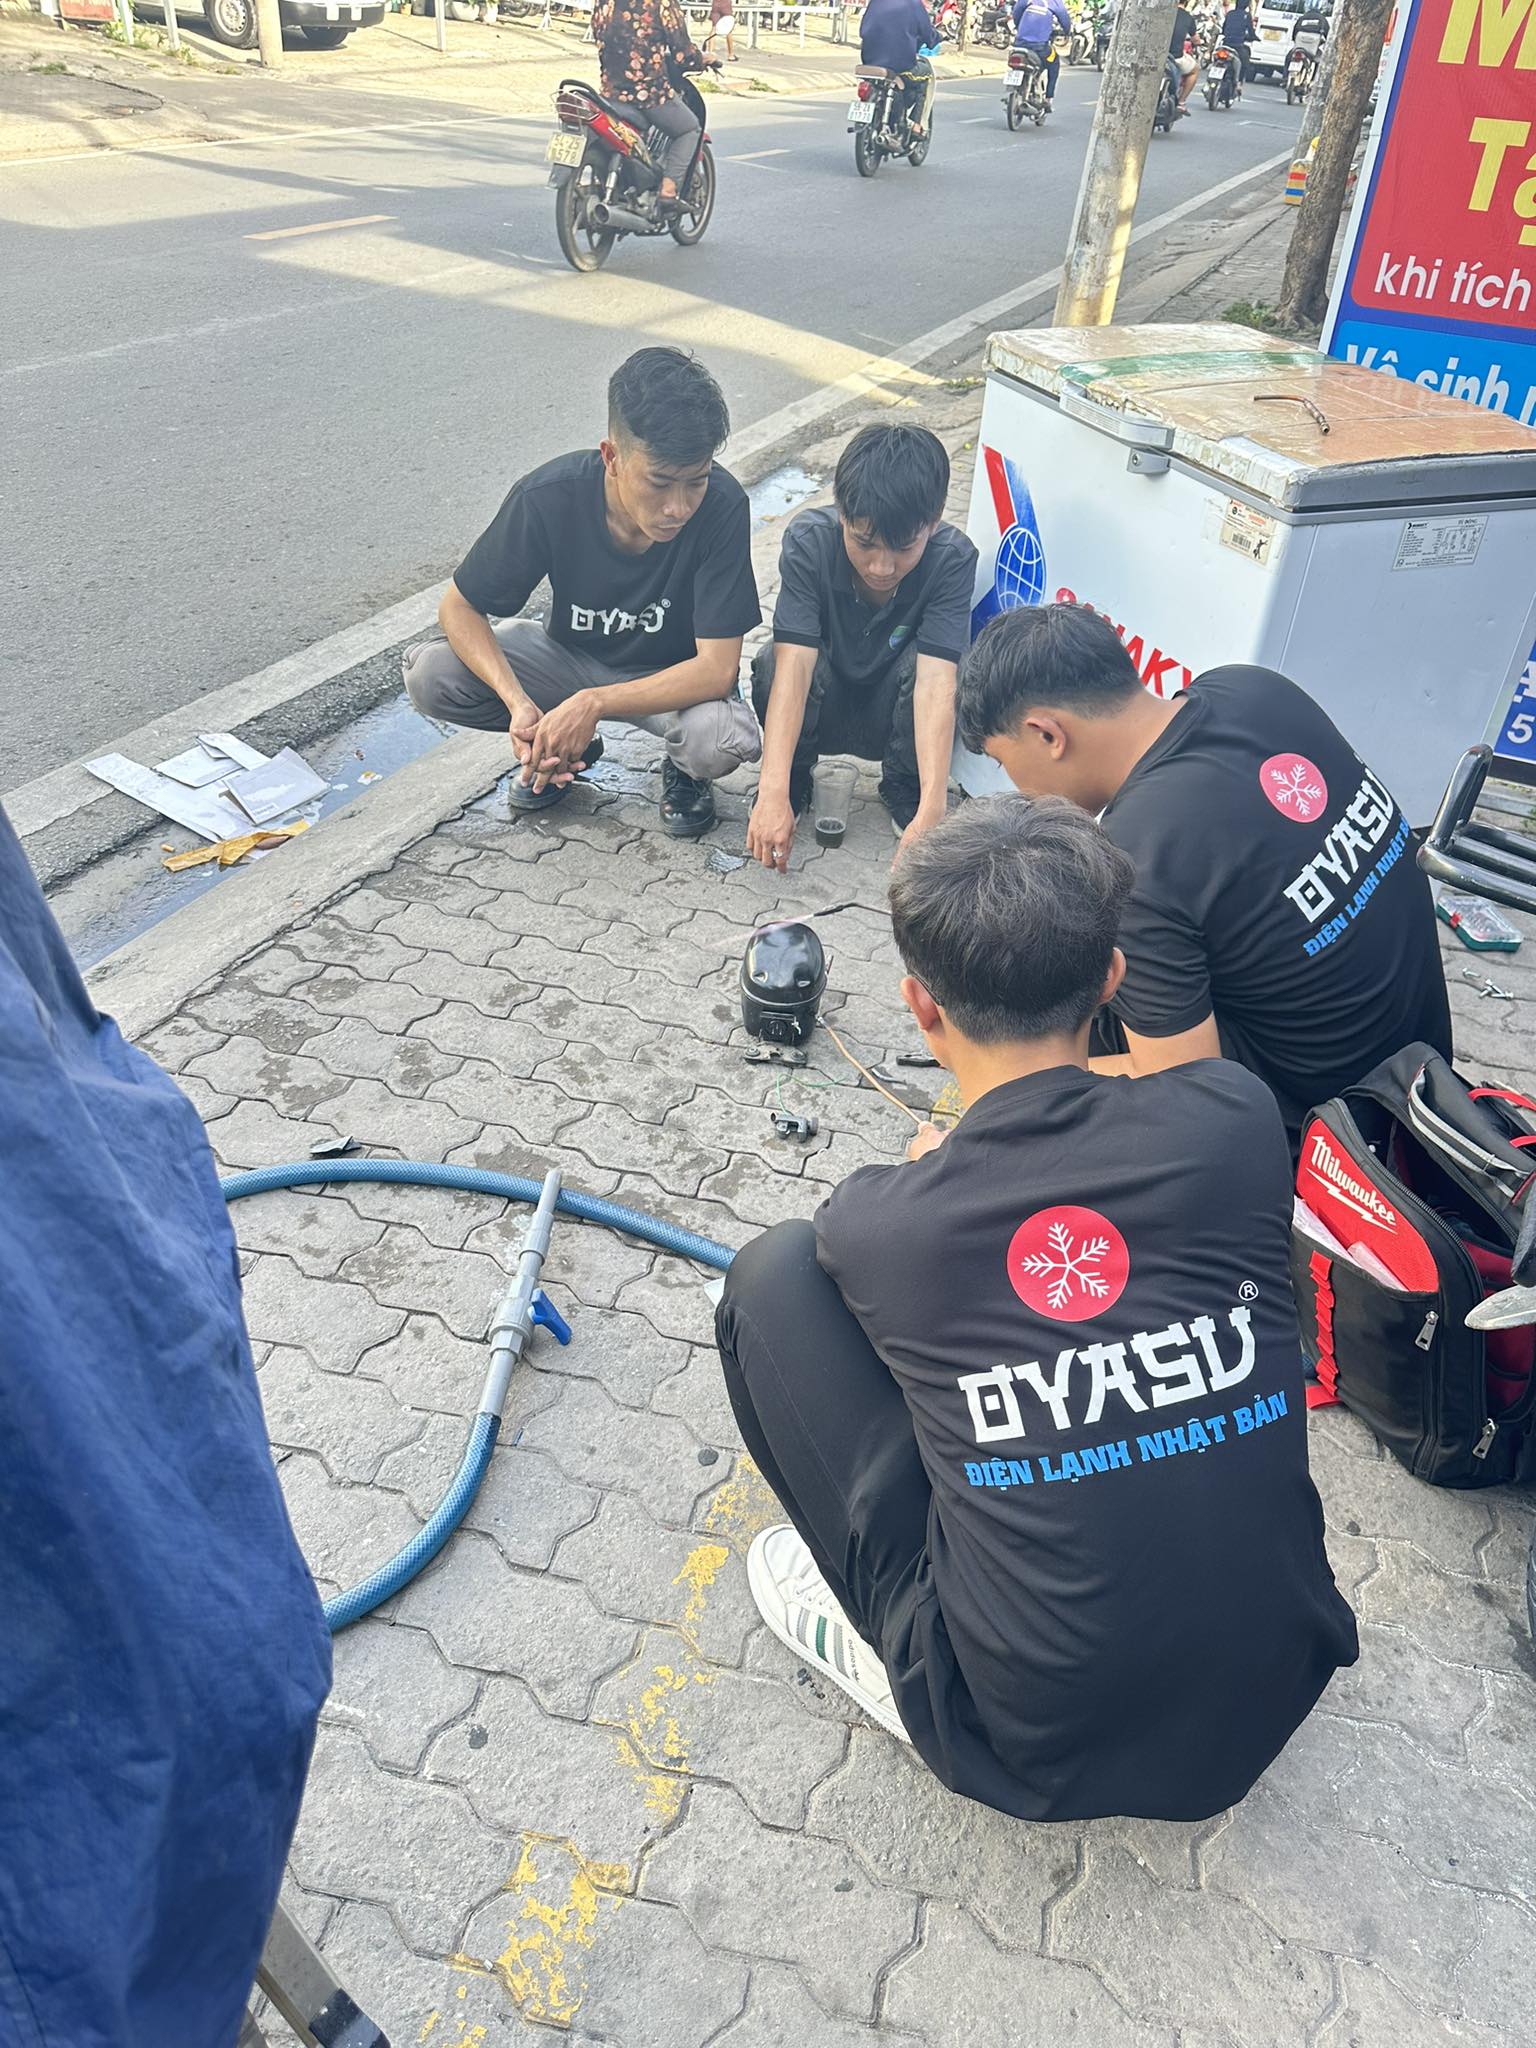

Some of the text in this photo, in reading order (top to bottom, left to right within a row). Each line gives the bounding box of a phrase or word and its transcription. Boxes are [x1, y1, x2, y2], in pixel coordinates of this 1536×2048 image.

[1374, 252, 1532, 312] khi tích
[1283, 767, 1394, 923] OYASU
[1303, 912, 1349, 957] ĐIỆN
[1345, 870, 1380, 920] LẠNH
[1311, 1136, 1397, 1226] Milwaukee
[957, 1305, 1256, 1443] OYASU
[964, 1391, 1288, 1491] ĐIỆN LẠNH NHẬT BẢN
